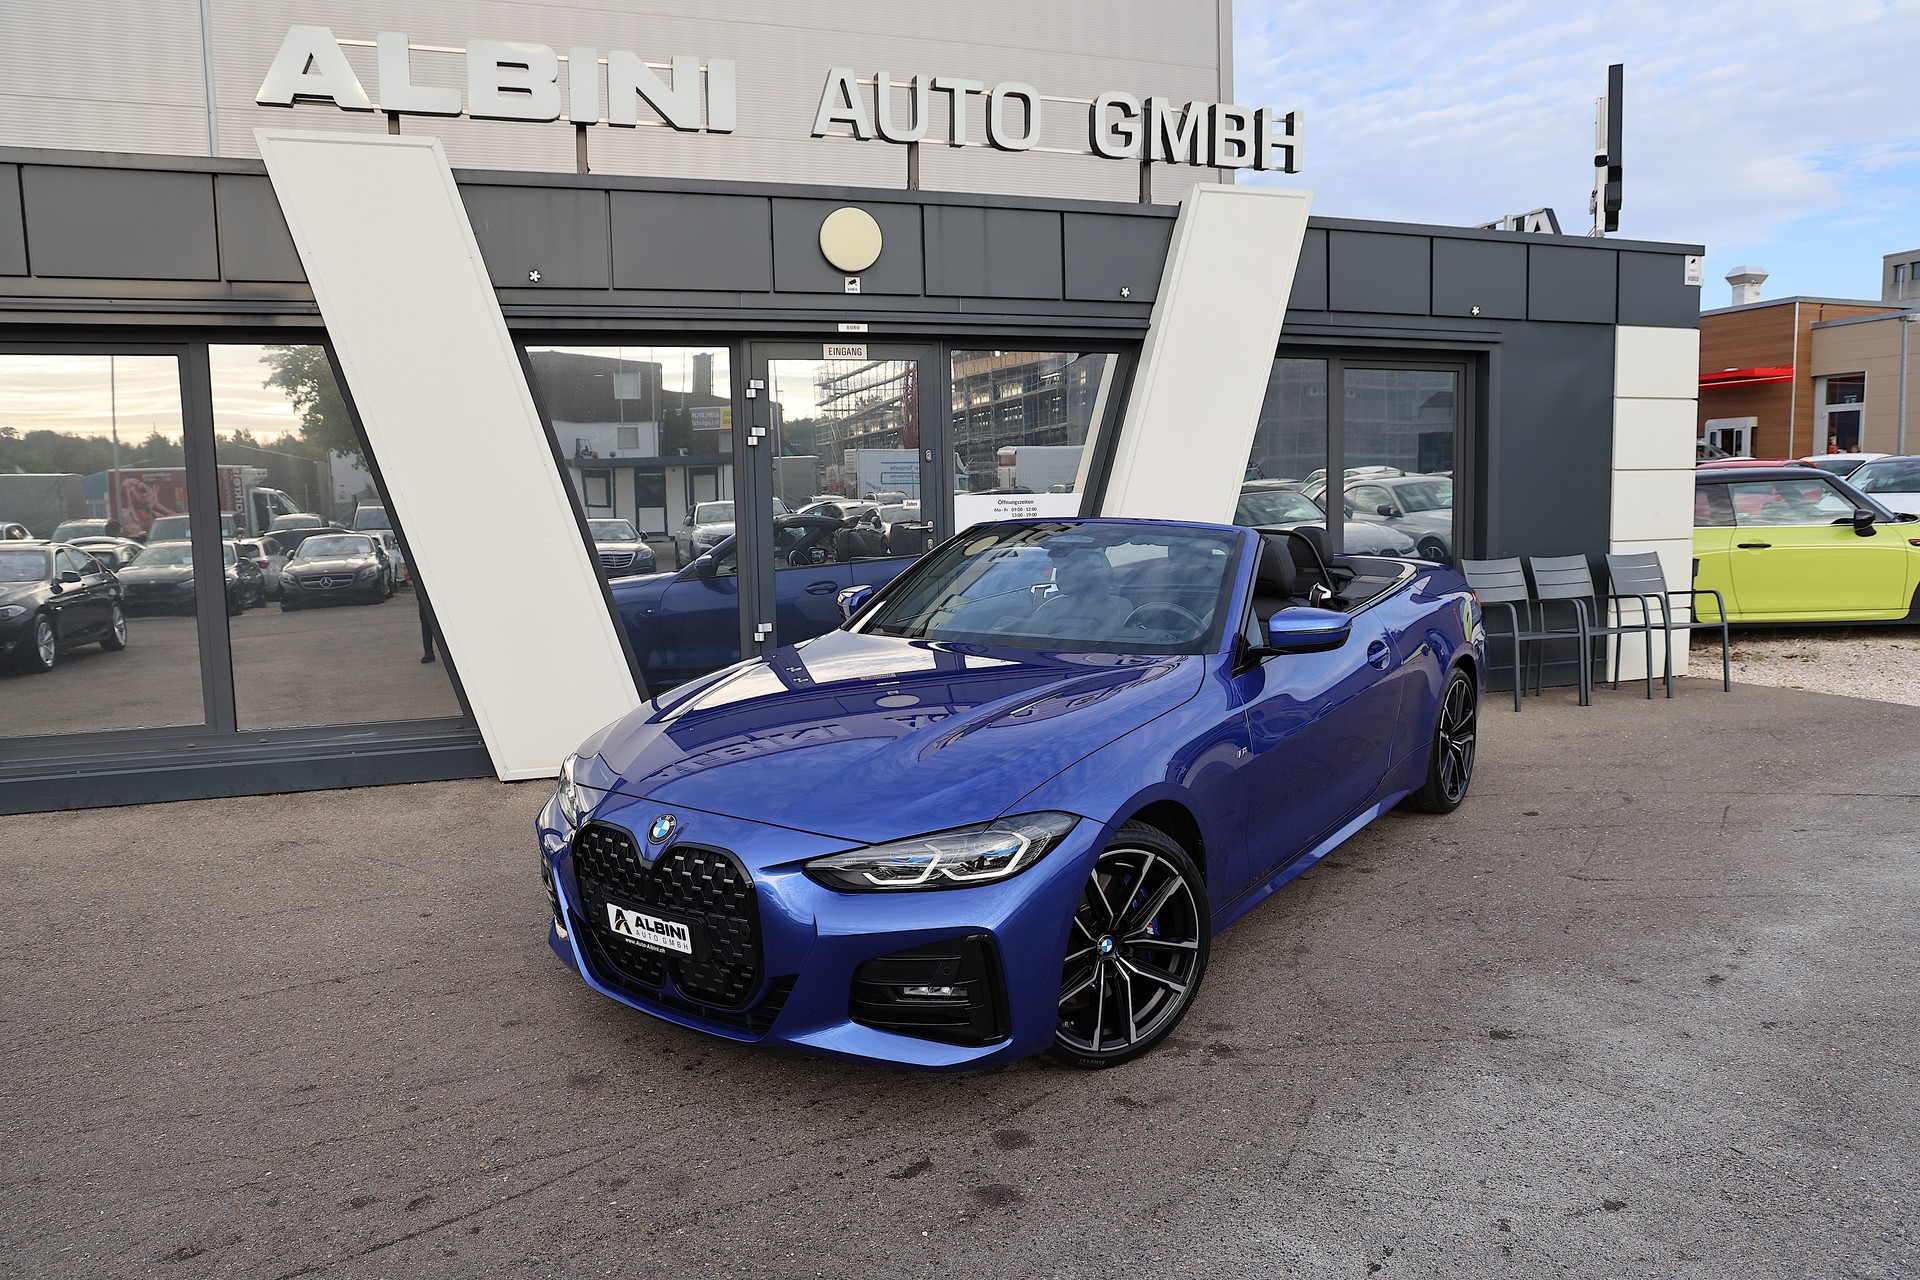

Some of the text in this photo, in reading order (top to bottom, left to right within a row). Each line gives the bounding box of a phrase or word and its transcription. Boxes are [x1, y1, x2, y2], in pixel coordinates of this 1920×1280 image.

[256, 25, 1304, 174] ALBINI AUTO GMBH
[828, 347, 863, 357] EINGANG
[634, 915, 687, 941] ALBINI
[625, 938, 666, 954] www.Auto-Albini.ch
[635, 929, 689, 950] AUTO GMBH
